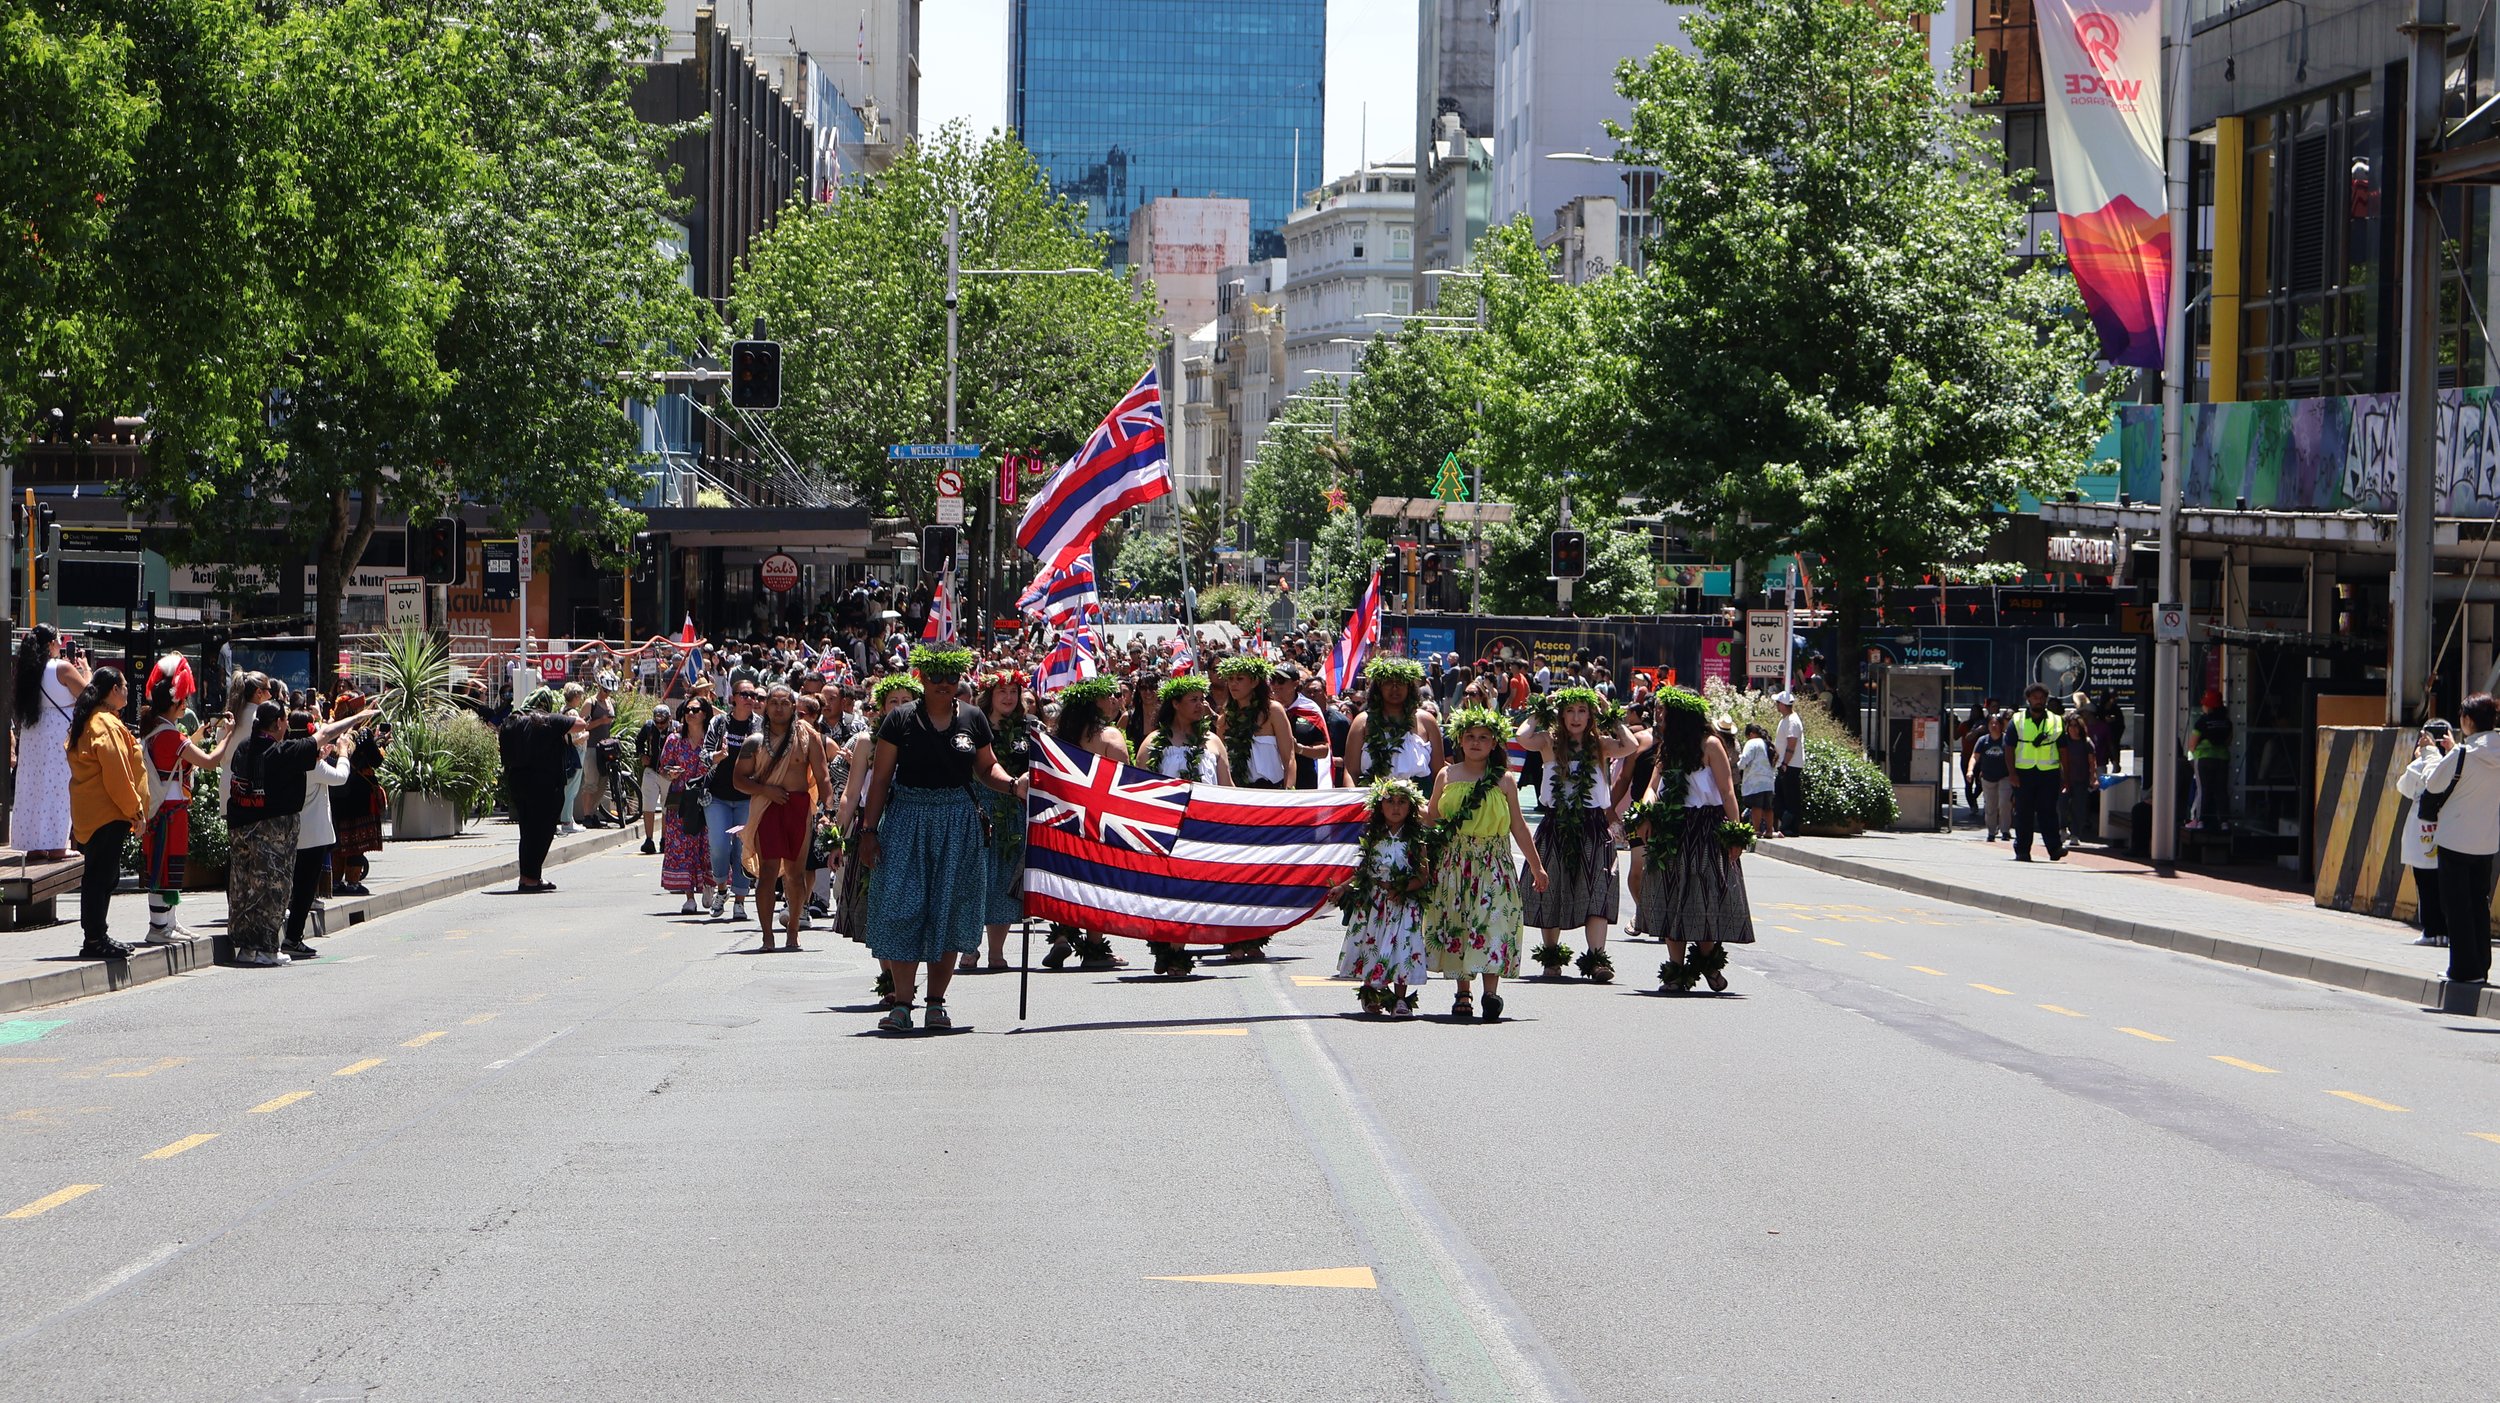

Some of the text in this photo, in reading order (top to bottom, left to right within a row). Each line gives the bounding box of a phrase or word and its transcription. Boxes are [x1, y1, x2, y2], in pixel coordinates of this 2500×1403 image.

[910, 446, 955, 456] WELLESLEY
[766, 560, 795, 573] Sal's
[398, 600, 412, 609] GV
[392, 614, 420, 624] LANE
[448, 618, 494, 637] ASTES
[1760, 634, 1773, 642] GV
[1534, 640, 1571, 650] Acecco
[2091, 646, 2136, 654] Auckland
[1753, 648, 1780, 657] LANE
[1904, 647, 1947, 657] YoYoSo
[1545, 654, 1570, 663] open
[1947, 658, 1964, 668] for
[2091, 656, 2136, 666] Company
[2091, 666, 2100, 675] is
[2101, 667, 2125, 676] open
[2091, 677, 2133, 685] business
